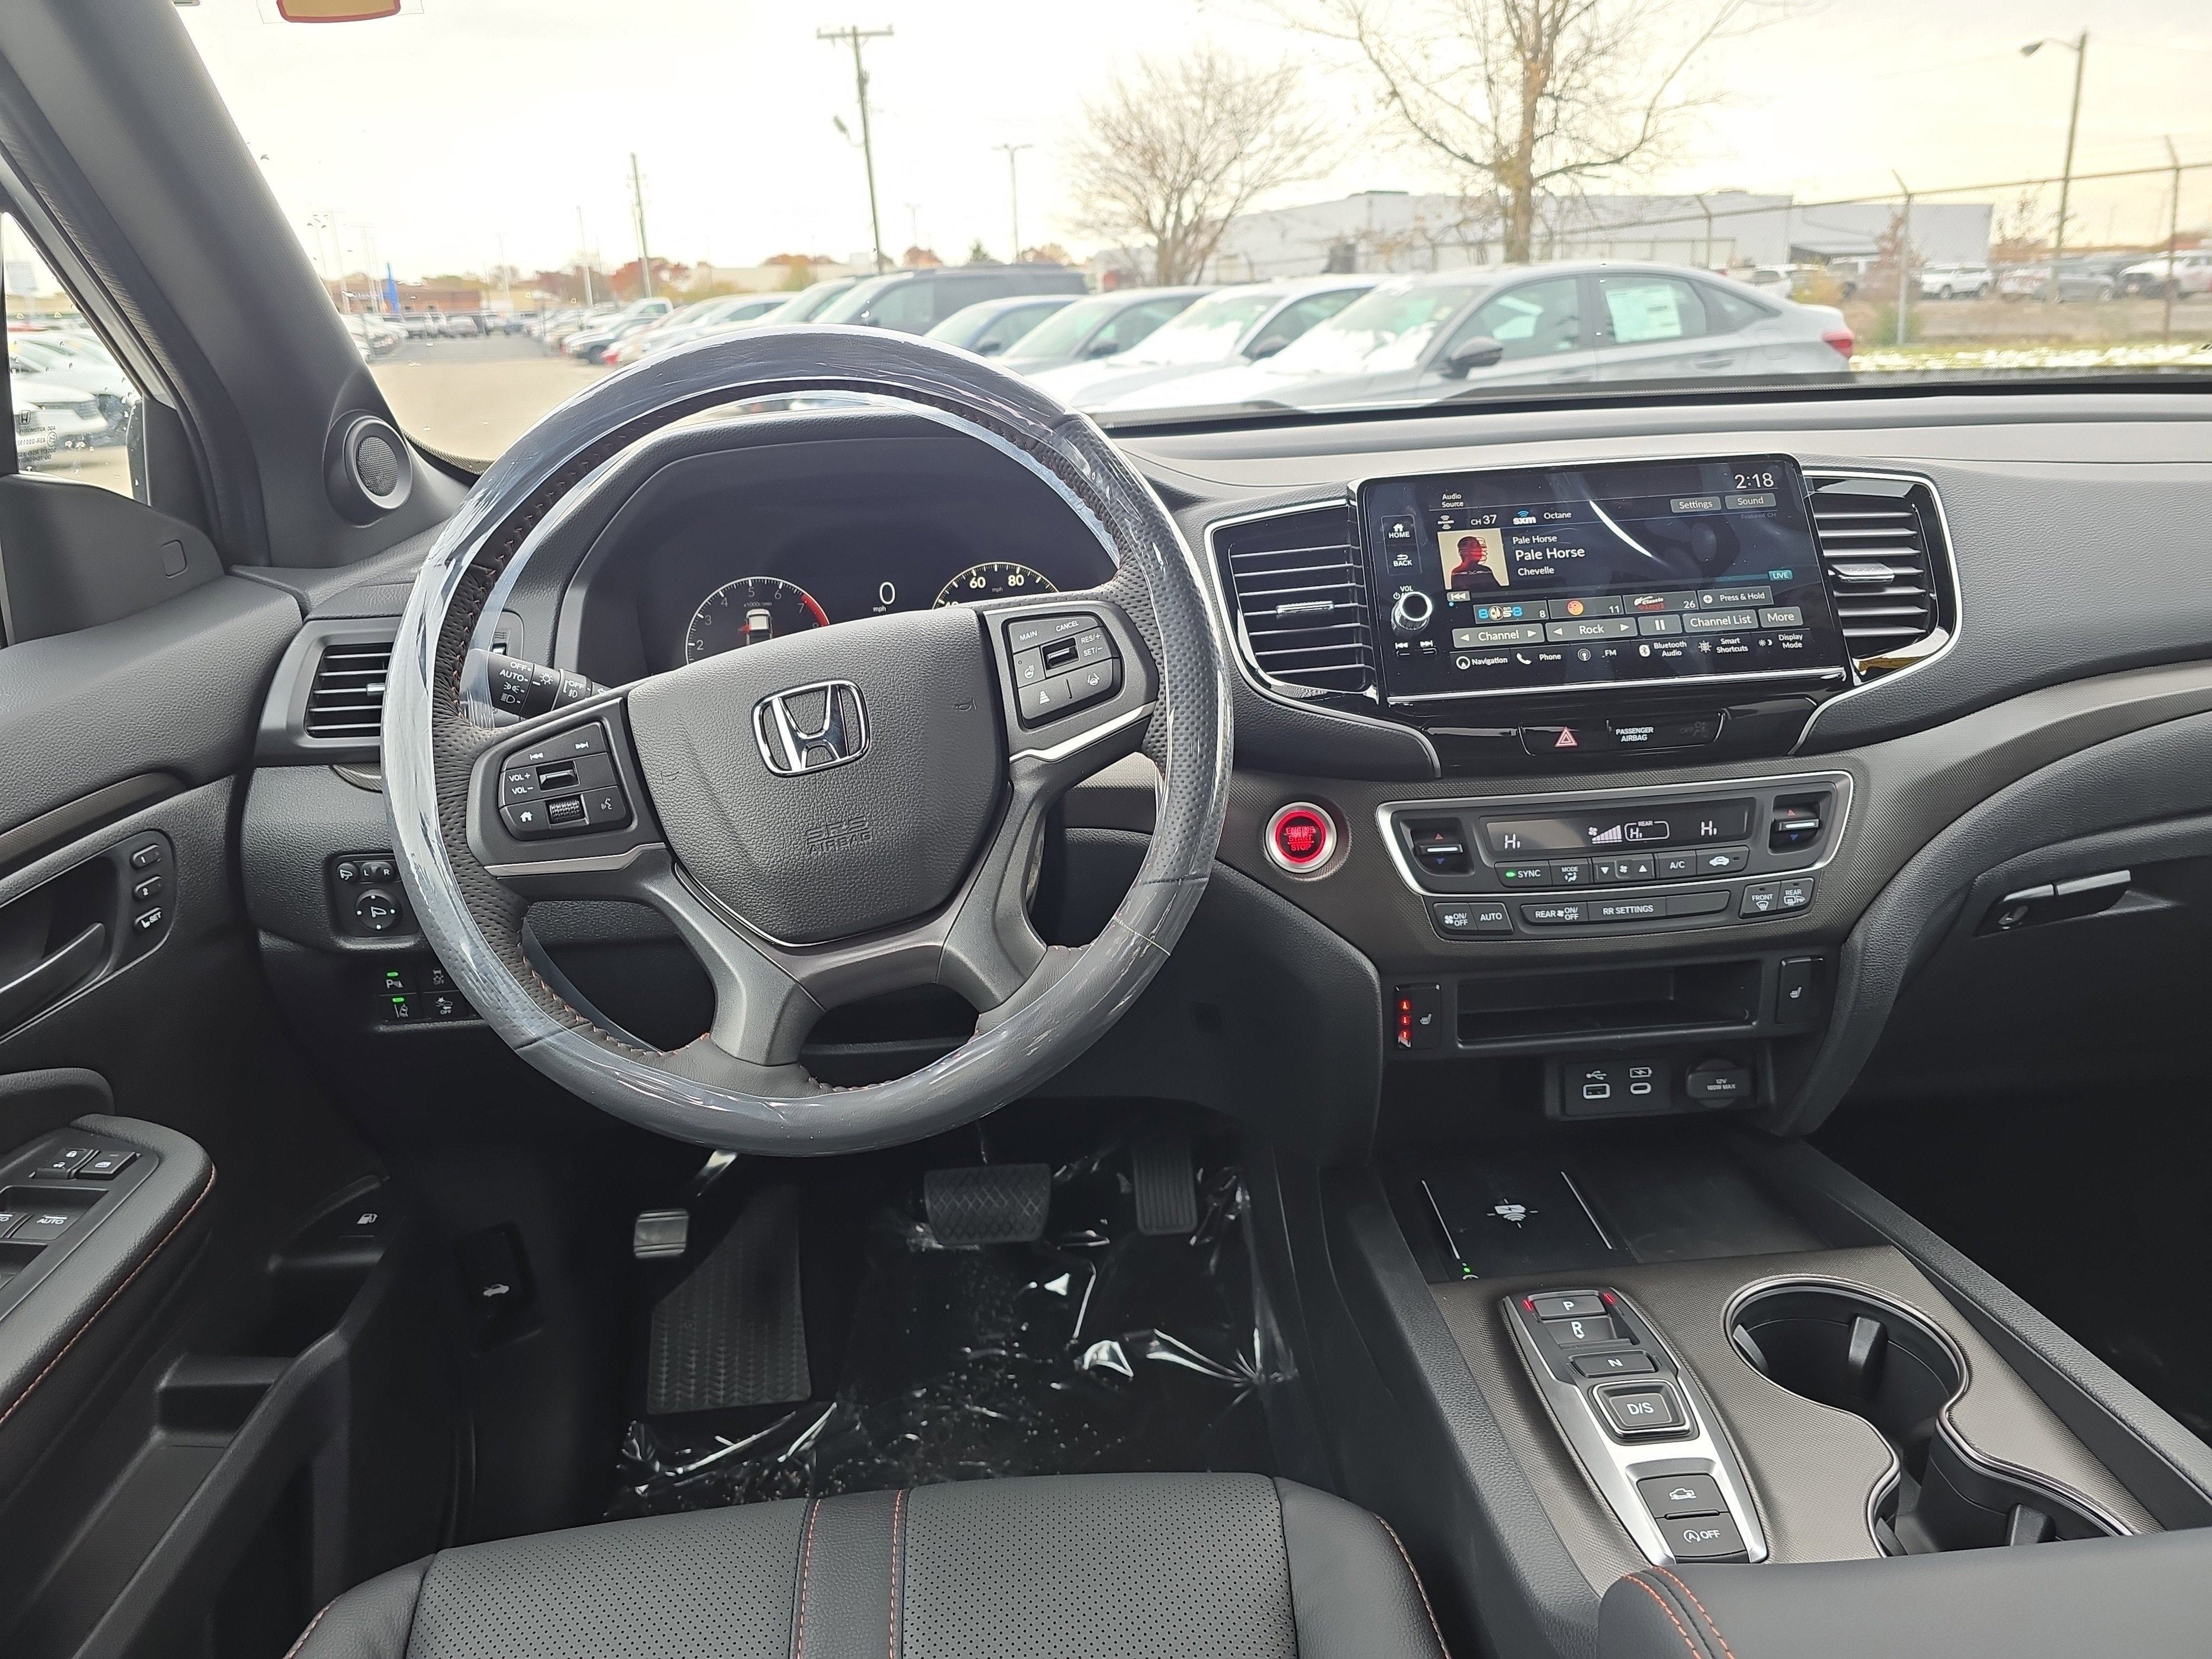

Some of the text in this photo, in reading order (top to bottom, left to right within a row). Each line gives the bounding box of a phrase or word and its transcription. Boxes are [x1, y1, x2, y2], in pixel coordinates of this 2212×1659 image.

[1735, 473, 1774, 489] 2:18
[1679, 501, 1713, 510] Settings
[1737, 497, 1764, 505] Sound
[1483, 515, 1497, 524] 37
[1544, 511, 1572, 520] Octane
[1513, 535, 1558, 544] Pale Horse
[1515, 547, 1585, 561] Pale Horse
[1517, 567, 1554, 576] Chevelle
[969, 576, 986, 588] 60
[1008, 574, 1024, 587] 80
[749, 587, 755, 597] 5
[775, 589, 781, 600] 6
[879, 582, 896, 605] 0
[721, 597, 728, 607] 4
[1683, 600, 1695, 609] 26
[798, 603, 805, 613] 7
[1609, 606, 1620, 614] 11
[1539, 610, 1546, 618] 8
[1767, 613, 1795, 622] More
[705, 615, 712, 625] 3
[1690, 615, 1752, 628] Channel List
[1056, 620, 1079, 632] CANCEL
[1579, 625, 1604, 635] Rock
[1020, 630, 1038, 641] MAIN
[1081, 633, 1101, 644] RES/+
[1478, 630, 1519, 641] Channel
[1778, 634, 1803, 642] Display
[696, 640, 704, 651] 2
[1654, 641, 1687, 649] Bluetooth
[1716, 645, 1748, 653] Shortcuts
[1539, 653, 1561, 661] Phone
[1662, 649, 1682, 657] Audio
[510, 661, 528, 671] OFF
[1472, 657, 1508, 666] Navigation
[499, 668, 524, 682] AUTO
[569, 680, 585, 689] OFF
[1616, 726, 1654, 736] PASSENGER
[805, 815, 868, 841] SRS
[1285, 826, 1316, 834] ENGINE
[1669, 860, 1685, 870] A/C
[1517, 870, 1541, 878] SYNC
[1535, 910, 1556, 918] REAR
[1603, 905, 1654, 916] RR SETTINGS
[149, 911, 162, 923] SET
[1480, 912, 1502, 921] AUTO
[1454, 919, 1468, 927] OFF
[1562, 1301, 1574, 1310] P
[1571, 1321, 1584, 1334] R
[1607, 1359, 1623, 1367] N
[1626, 1402, 1654, 1415] D/S
[1700, 1529, 1720, 1539] OFF
